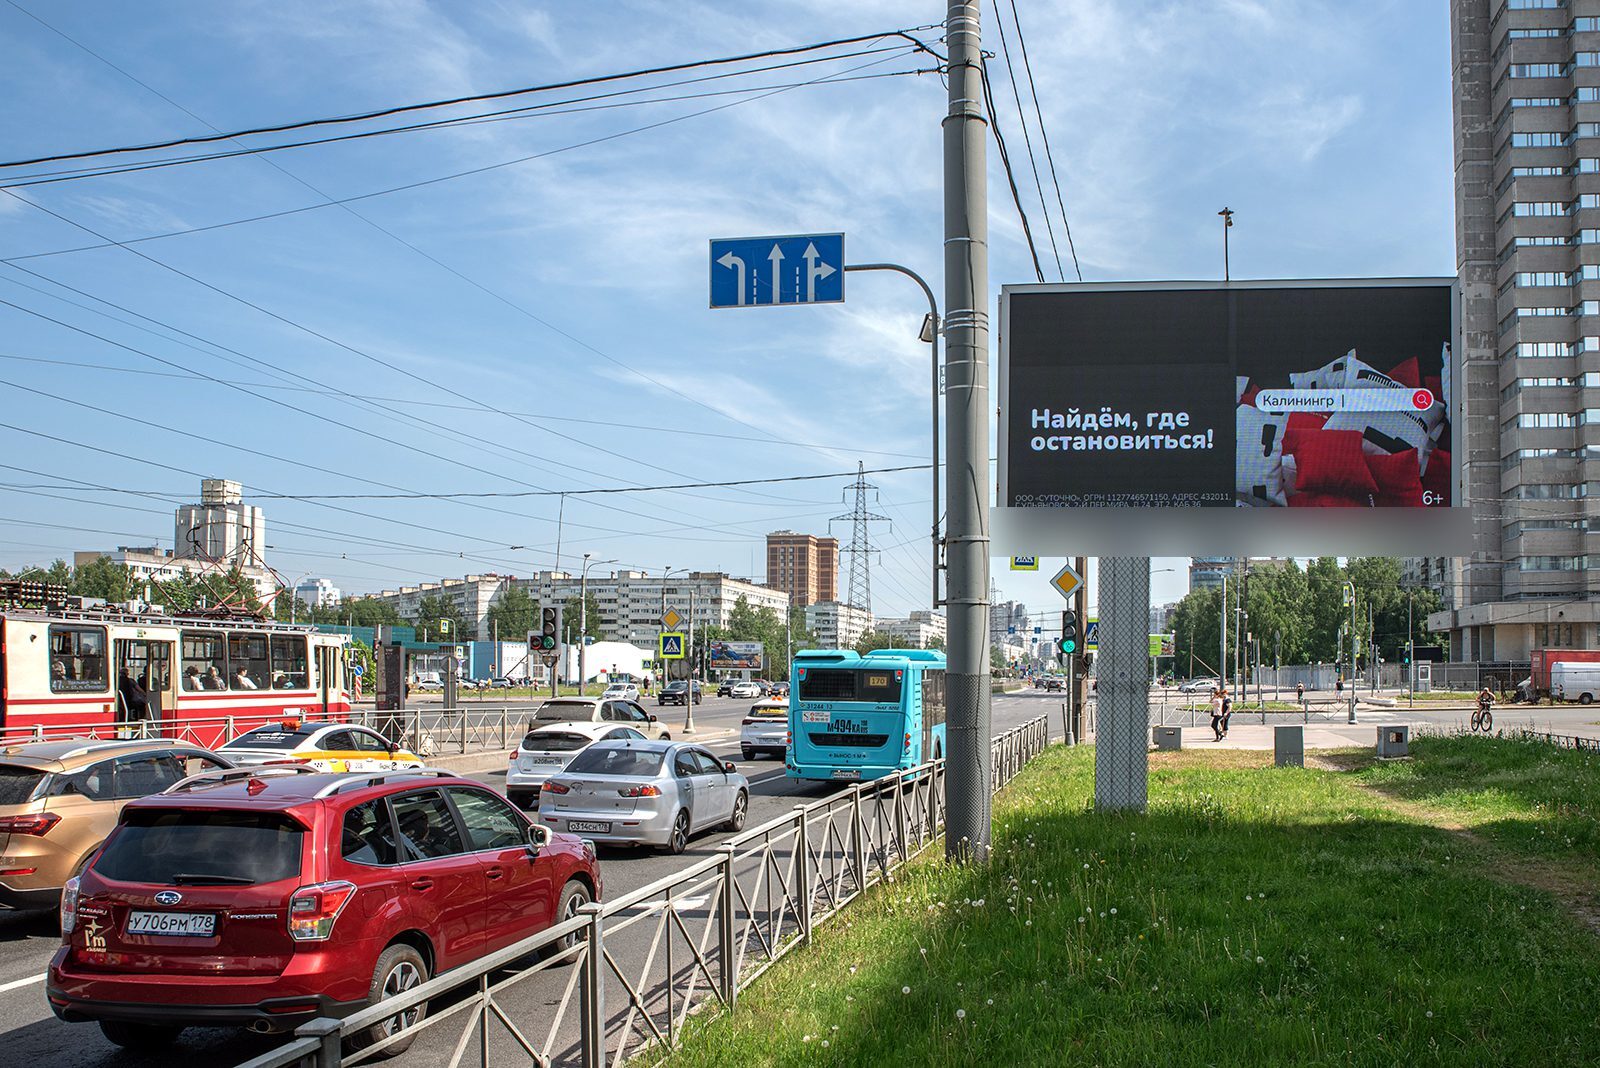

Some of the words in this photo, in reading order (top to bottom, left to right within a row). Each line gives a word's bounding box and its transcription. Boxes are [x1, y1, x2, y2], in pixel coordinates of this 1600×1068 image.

[1262, 394, 1334, 408] Калинингр
[1031, 407, 1139, 430] Найдём,
[1146, 411, 1190, 430] где
[1030, 429, 1214, 451] остановиться!
[1015, 494, 1034, 502] ООО
[1083, 493, 1105, 502] ОГРН
[1171, 493, 1199, 501] АДРЕС
[1422, 490, 1444, 505] 6+
[133, 914, 188, 931] У706РМ
[191, 915, 213, 928] 178
